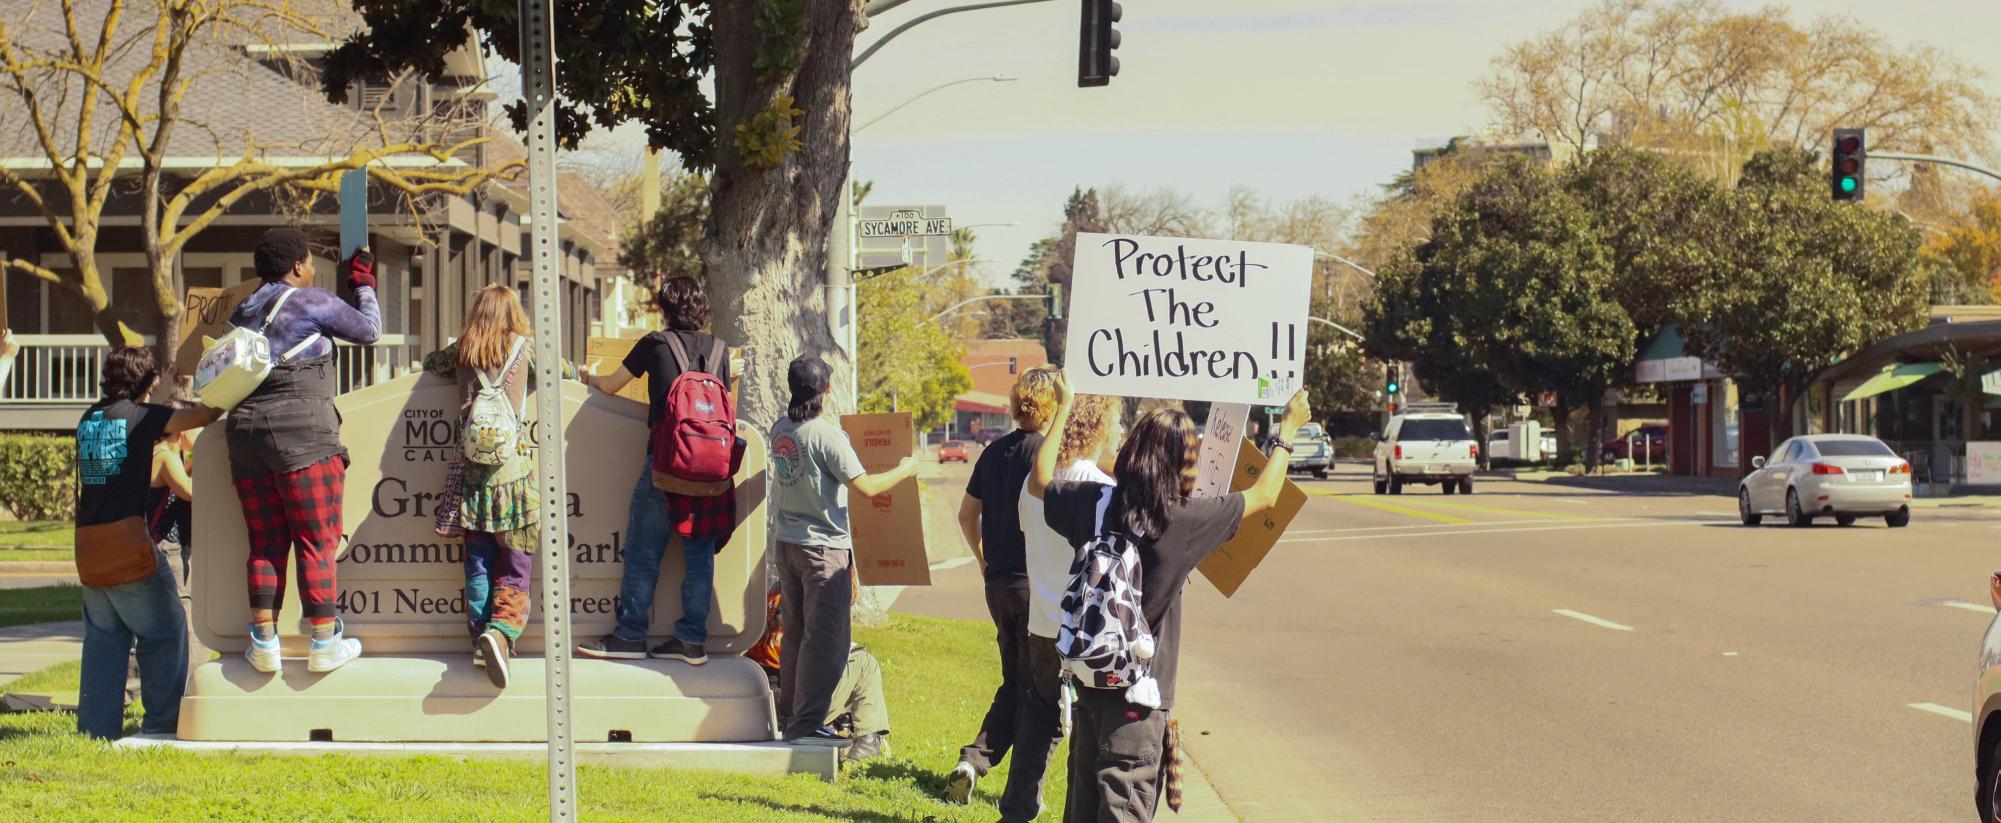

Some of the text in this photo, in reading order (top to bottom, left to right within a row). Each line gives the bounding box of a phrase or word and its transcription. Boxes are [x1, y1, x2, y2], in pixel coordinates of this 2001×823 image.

[864, 220, 948, 235] SYCAMORE AVE.
[1102, 238, 1269, 288] Protect
[1128, 288, 1219, 328] The
[404, 409, 444, 419] CITY OF
[336, 590, 383, 614] 401
[393, 588, 466, 614] Need
